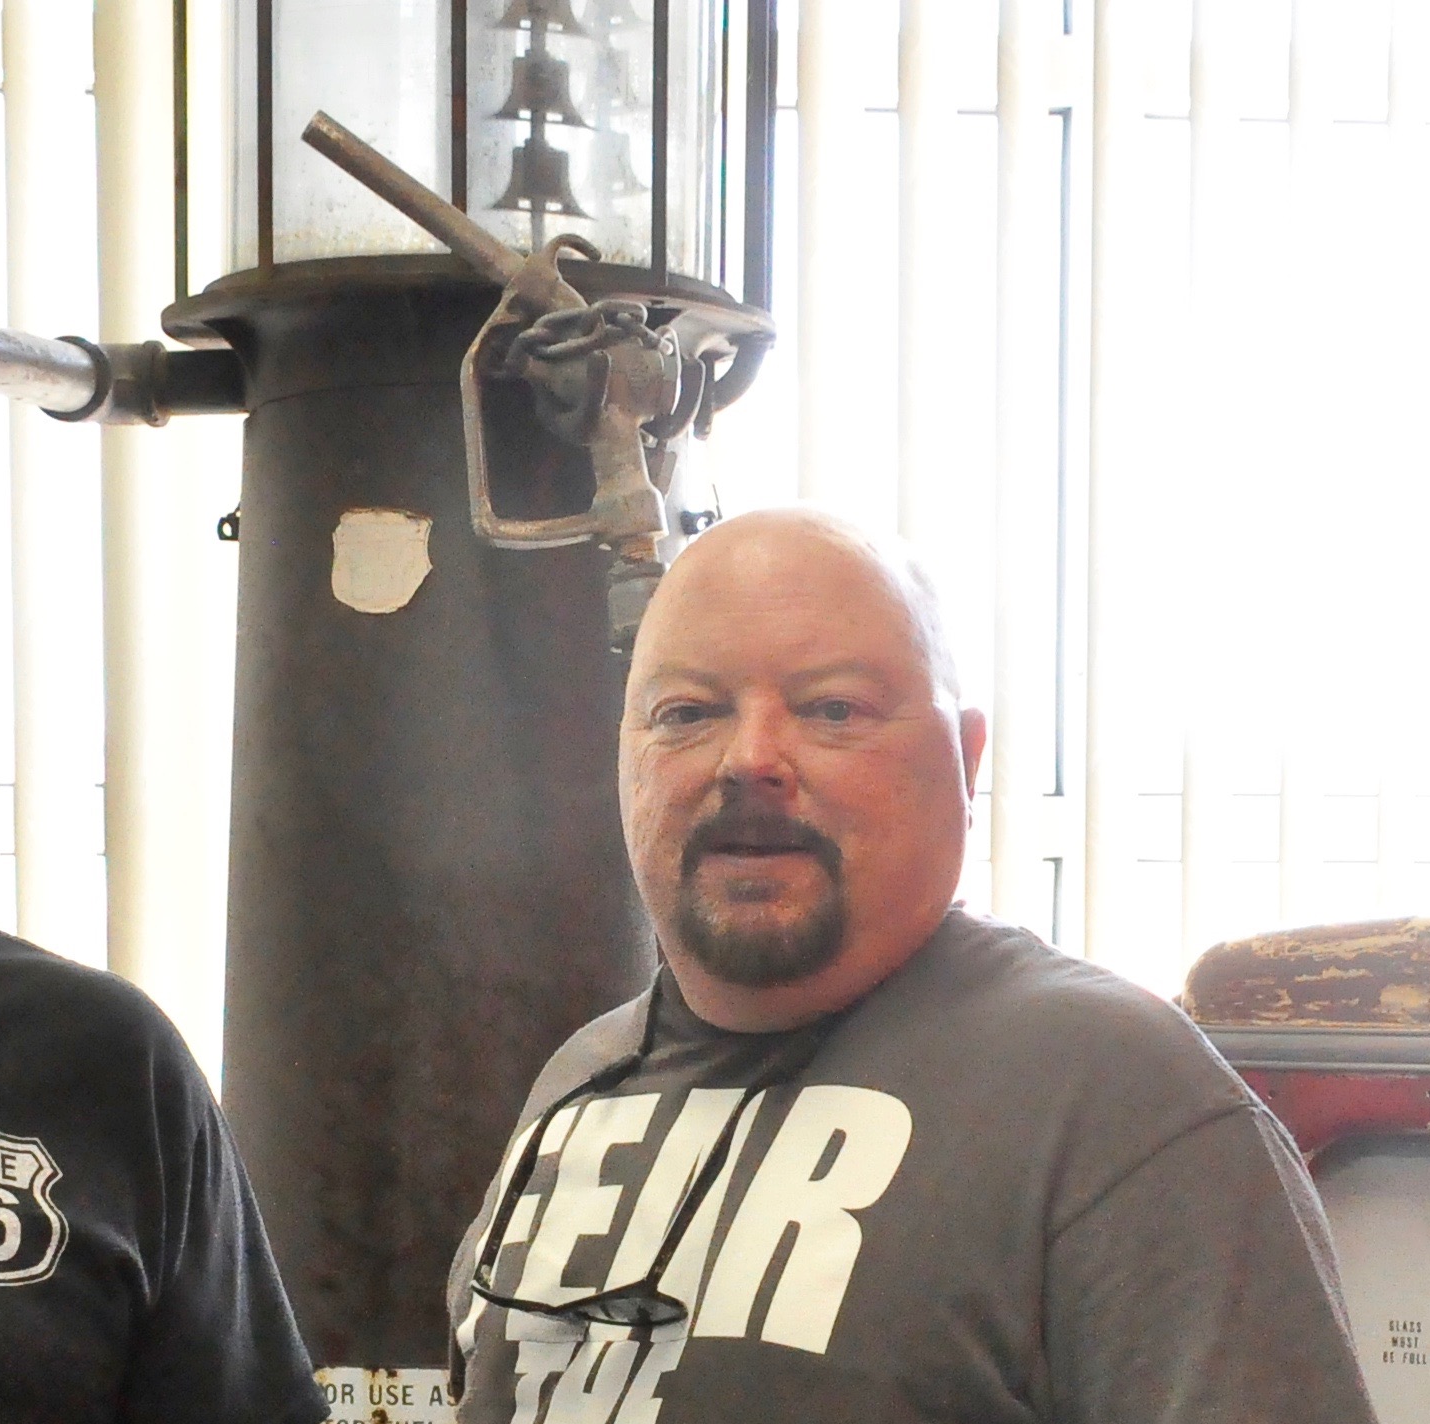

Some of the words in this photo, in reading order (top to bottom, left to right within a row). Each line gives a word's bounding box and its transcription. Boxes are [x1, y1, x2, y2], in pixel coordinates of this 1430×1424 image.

[1388, 1320, 1422, 1333] GLASS
[1391, 1336, 1420, 1349] MUST
[1402, 1353, 1427, 1366] FULL
[323, 1383, 355, 1405] OR
[368, 1384, 414, 1406] USE
